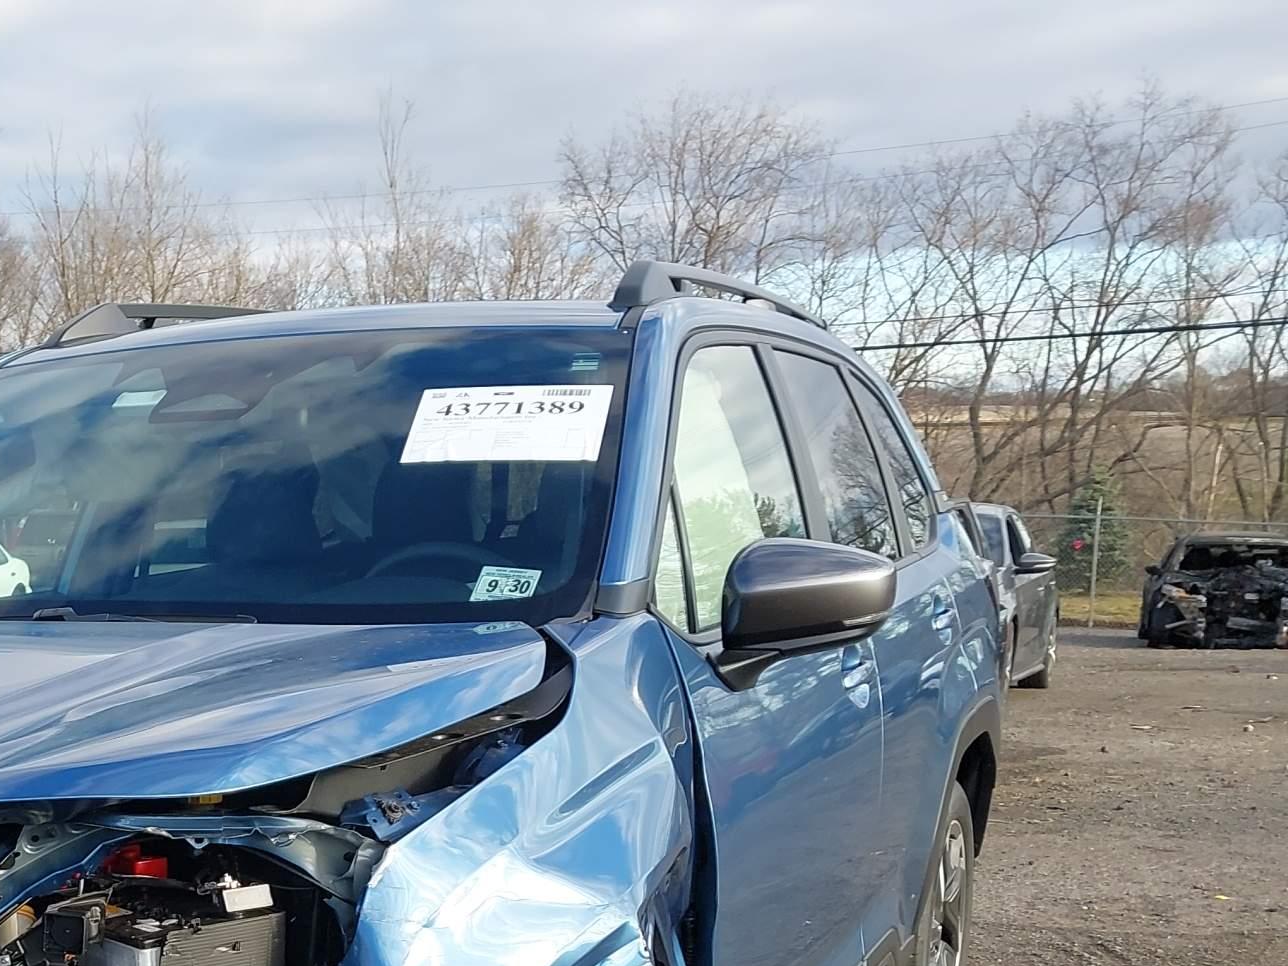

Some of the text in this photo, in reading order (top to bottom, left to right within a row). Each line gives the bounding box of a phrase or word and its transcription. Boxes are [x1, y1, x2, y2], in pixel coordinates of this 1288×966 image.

[436, 400, 585, 417] 43771389
[486, 579, 531, 594] 9 30
